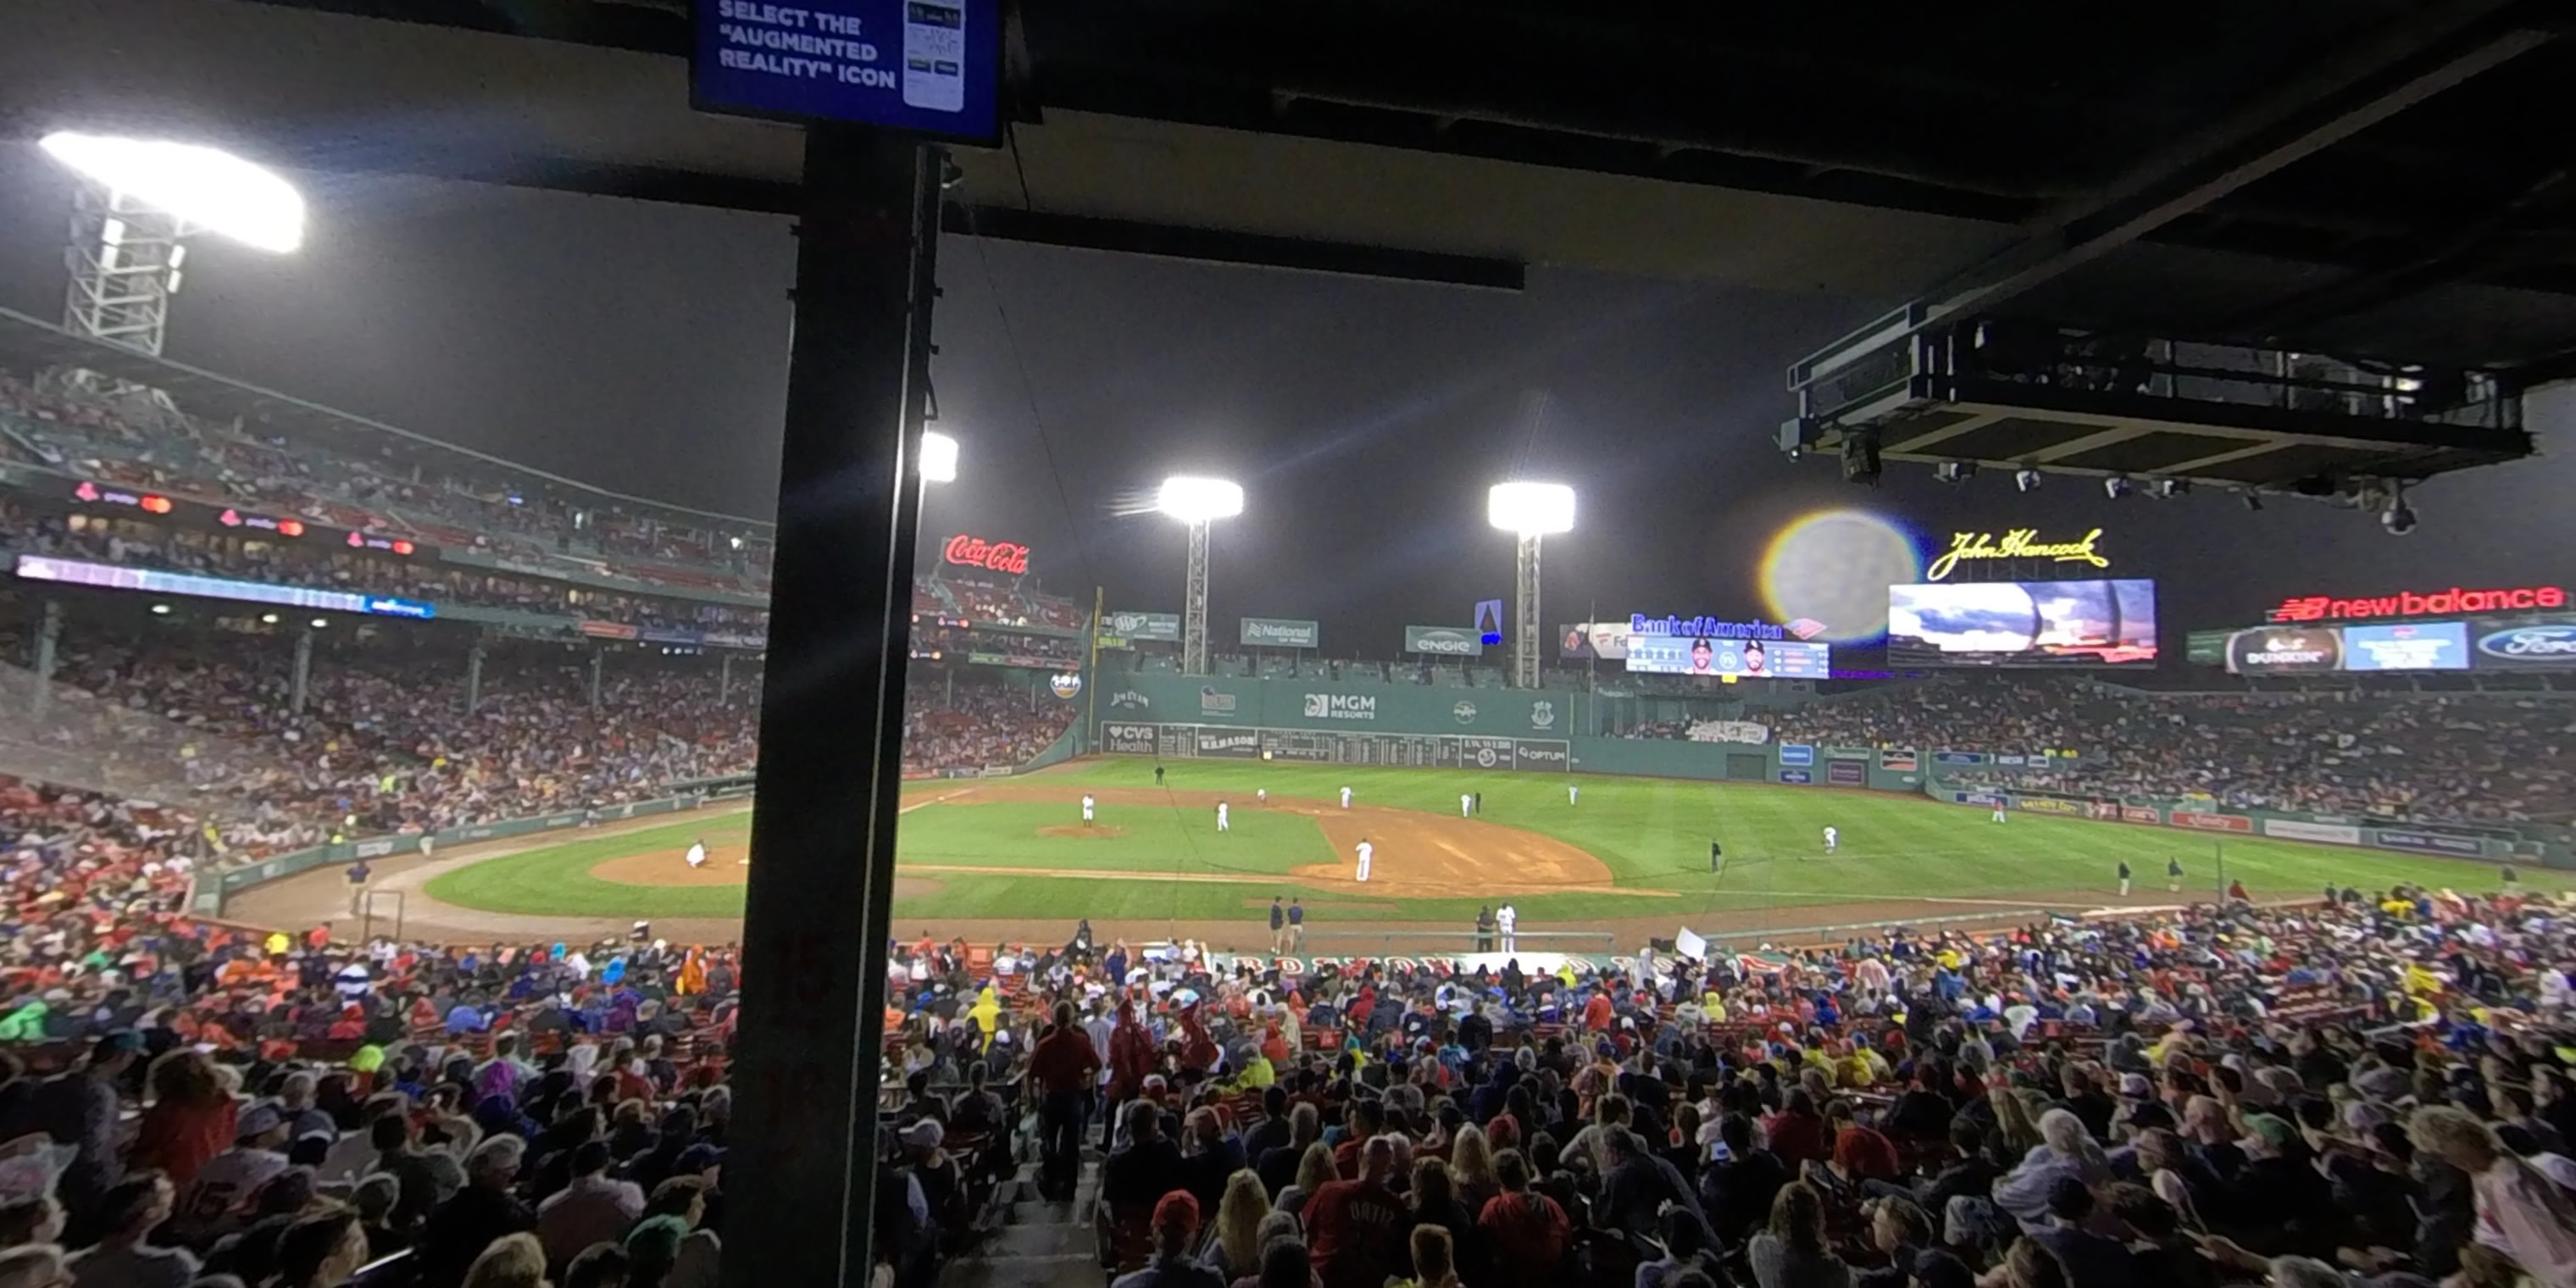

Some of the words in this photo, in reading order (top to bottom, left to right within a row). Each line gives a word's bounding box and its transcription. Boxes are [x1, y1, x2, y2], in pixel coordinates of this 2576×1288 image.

[719, 0, 811, 28] SELECT
[814, 12, 861, 36] THE
[838, 68, 896, 90] ICON
[1928, 531, 1998, 580] John
[1999, 528, 2109, 568] Hancock
[2331, 597, 2398, 618] new
[2401, 586, 2566, 615] balance
[1262, 625, 1312, 638] National
[1630, 613, 1681, 636] Bank
[1681, 615, 1702, 636] of
[1702, 616, 1785, 640] America
[1330, 694, 1376, 711] MGM
[1330, 710, 1375, 719] RESORTS
[1124, 726, 1153, 739] CVS
[1110, 738, 1152, 752] Health
[1529, 750, 1566, 762] OPTUM
